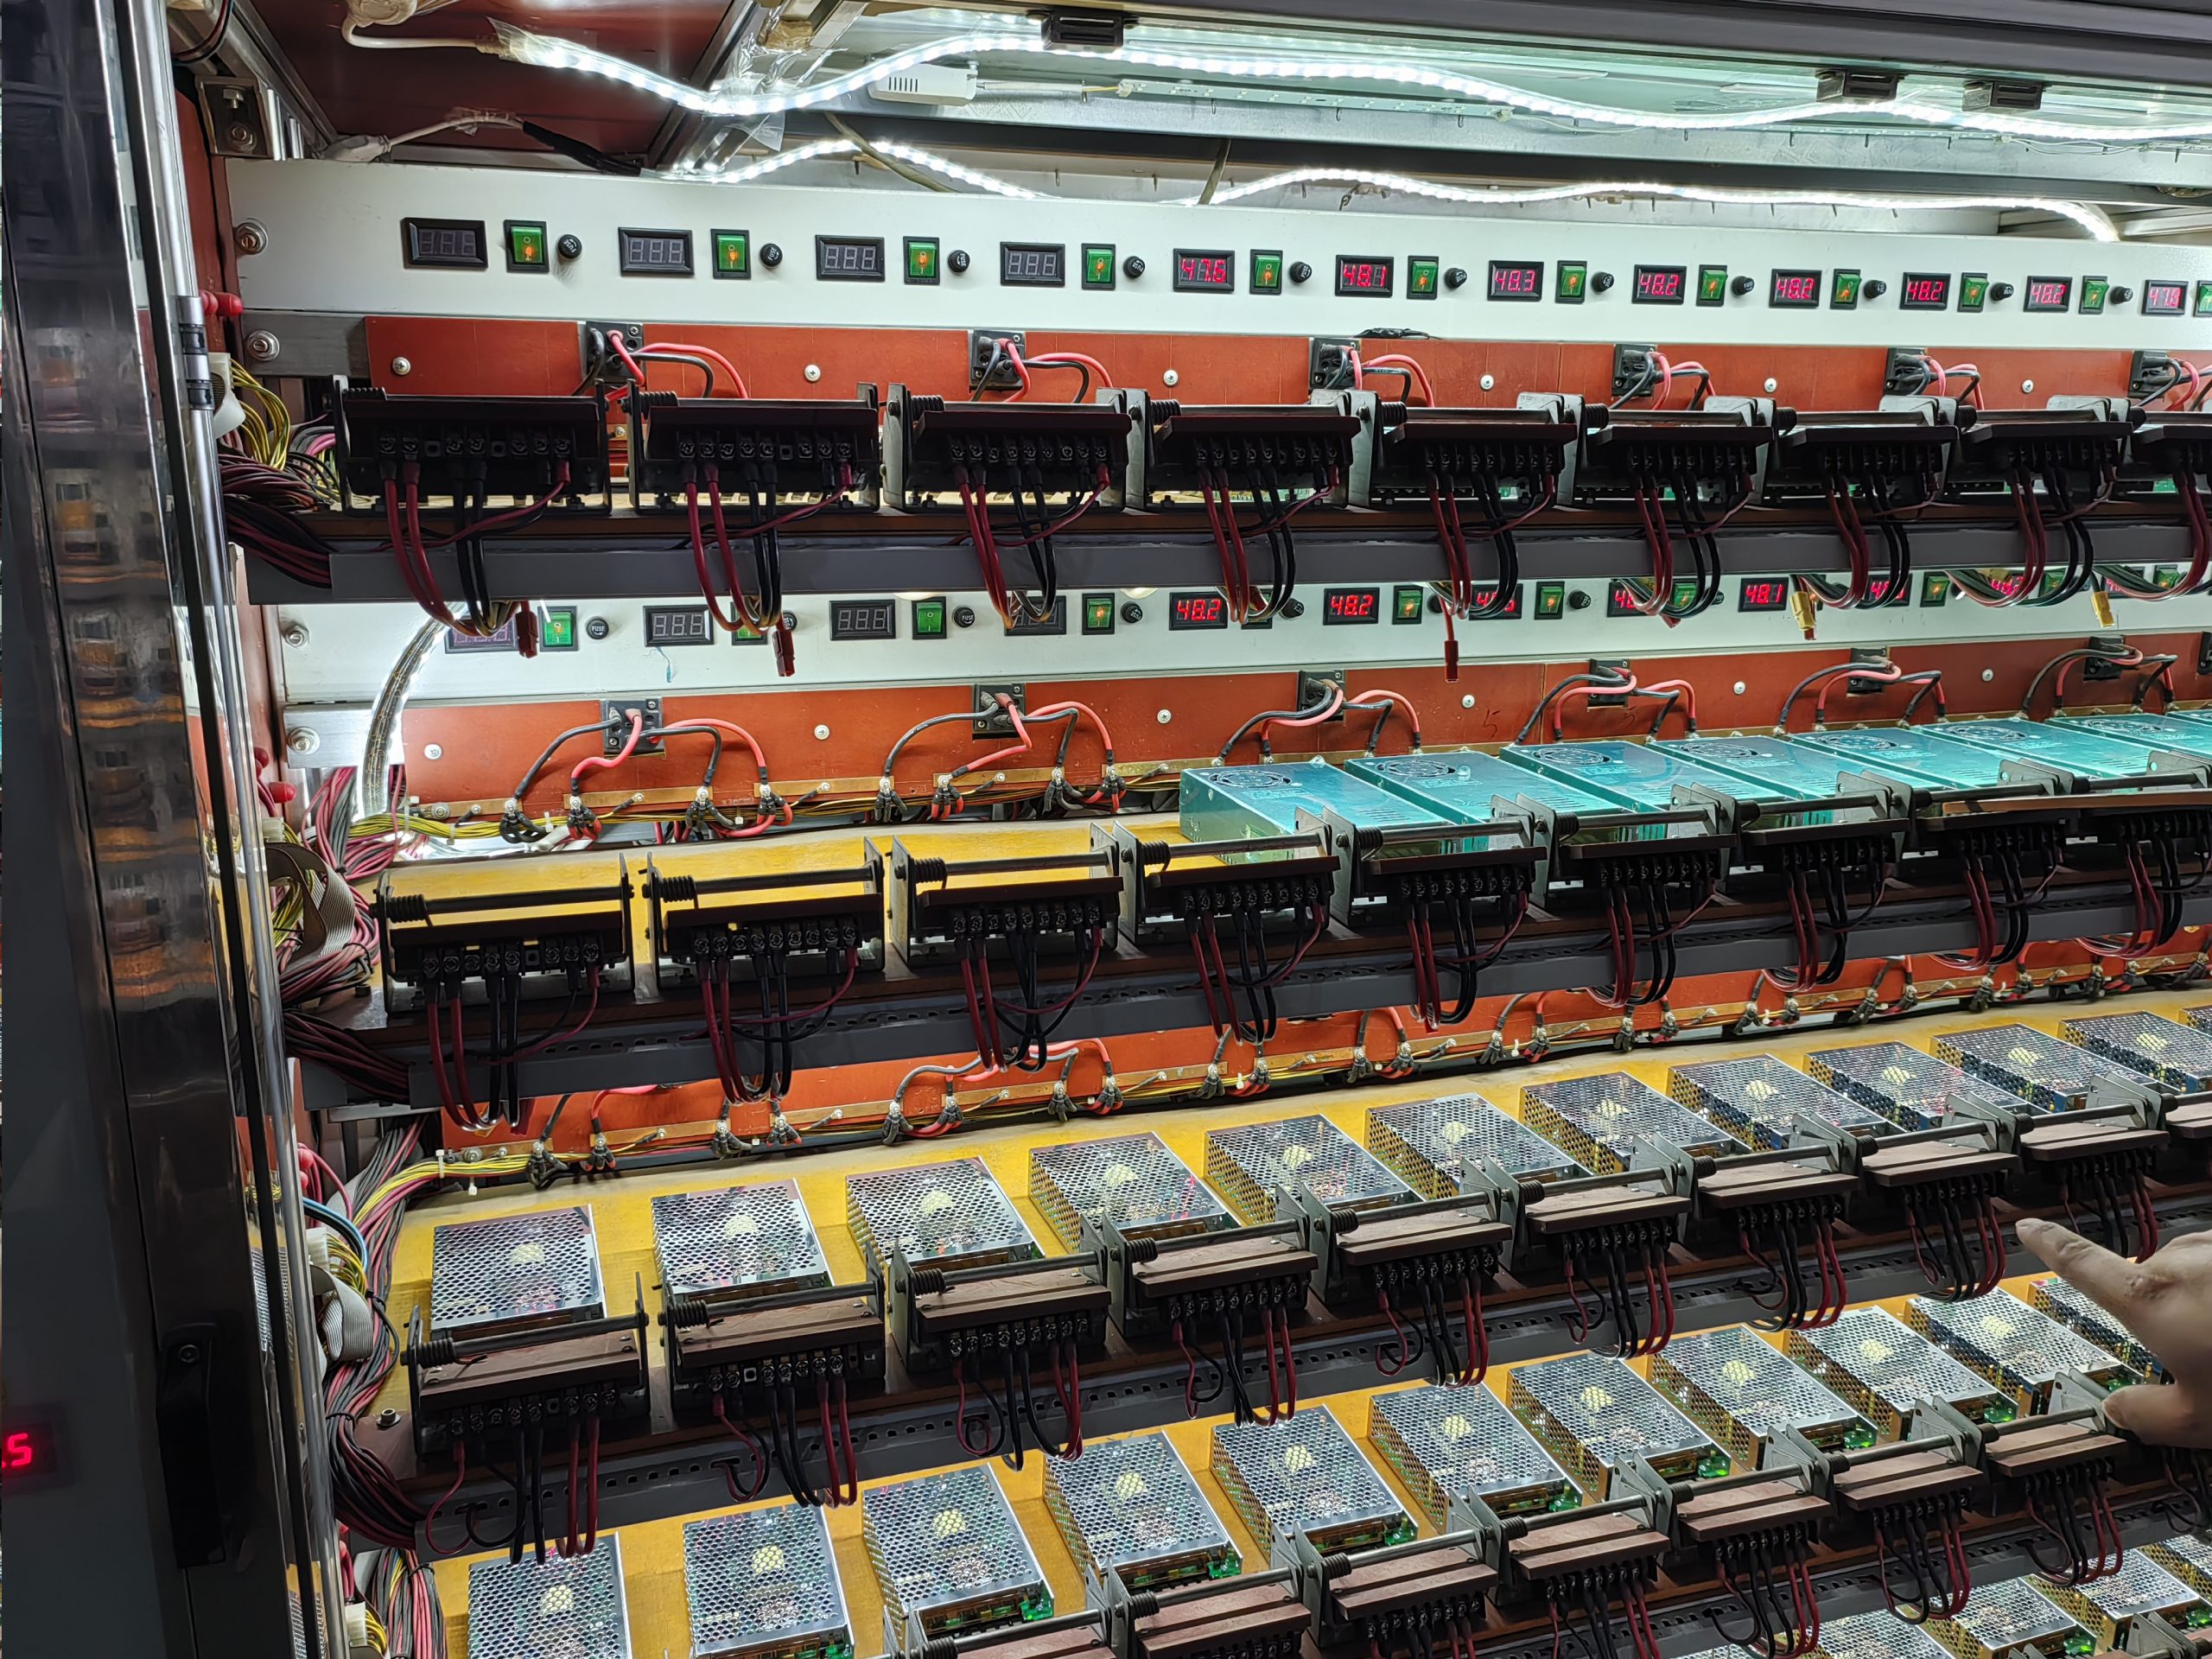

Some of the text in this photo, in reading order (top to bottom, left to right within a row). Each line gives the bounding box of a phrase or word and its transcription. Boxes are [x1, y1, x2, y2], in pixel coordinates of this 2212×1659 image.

[563, 238, 576, 253] FUSE
[767, 246, 777, 261] FUSE
[1181, 258, 1226, 283] 47.6
[1494, 270, 1535, 292] 48.3
[1639, 274, 1679, 296] 48.2
[1776, 277, 1815, 300] 48.2
[1907, 281, 1943, 302] 48.2
[2031, 283, 2066, 304] 48.2
[1176, 598, 1221, 621] 48.2
[1330, 594, 1374, 616] 48.2
